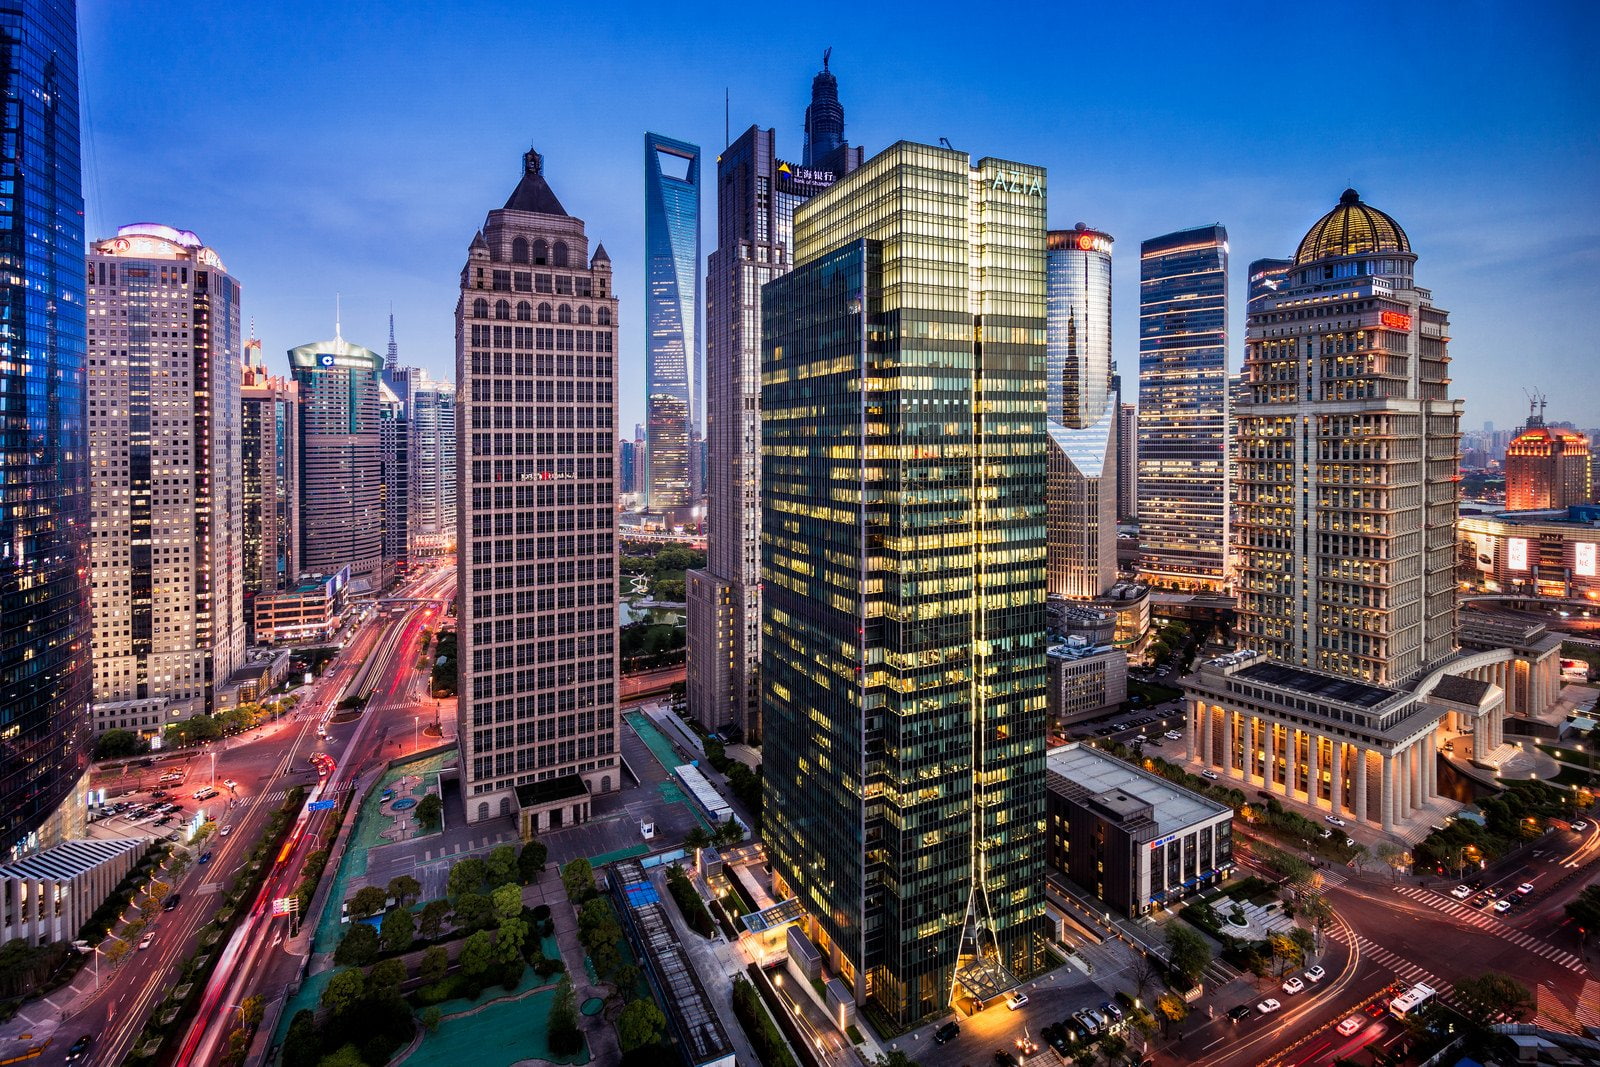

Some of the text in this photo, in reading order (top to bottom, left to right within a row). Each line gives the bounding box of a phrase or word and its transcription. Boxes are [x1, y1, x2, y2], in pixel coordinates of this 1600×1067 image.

[794, 167, 833, 181] 上海银行
[992, 169, 1043, 198] AZIA
[1382, 311, 1411, 330] 中国平安
